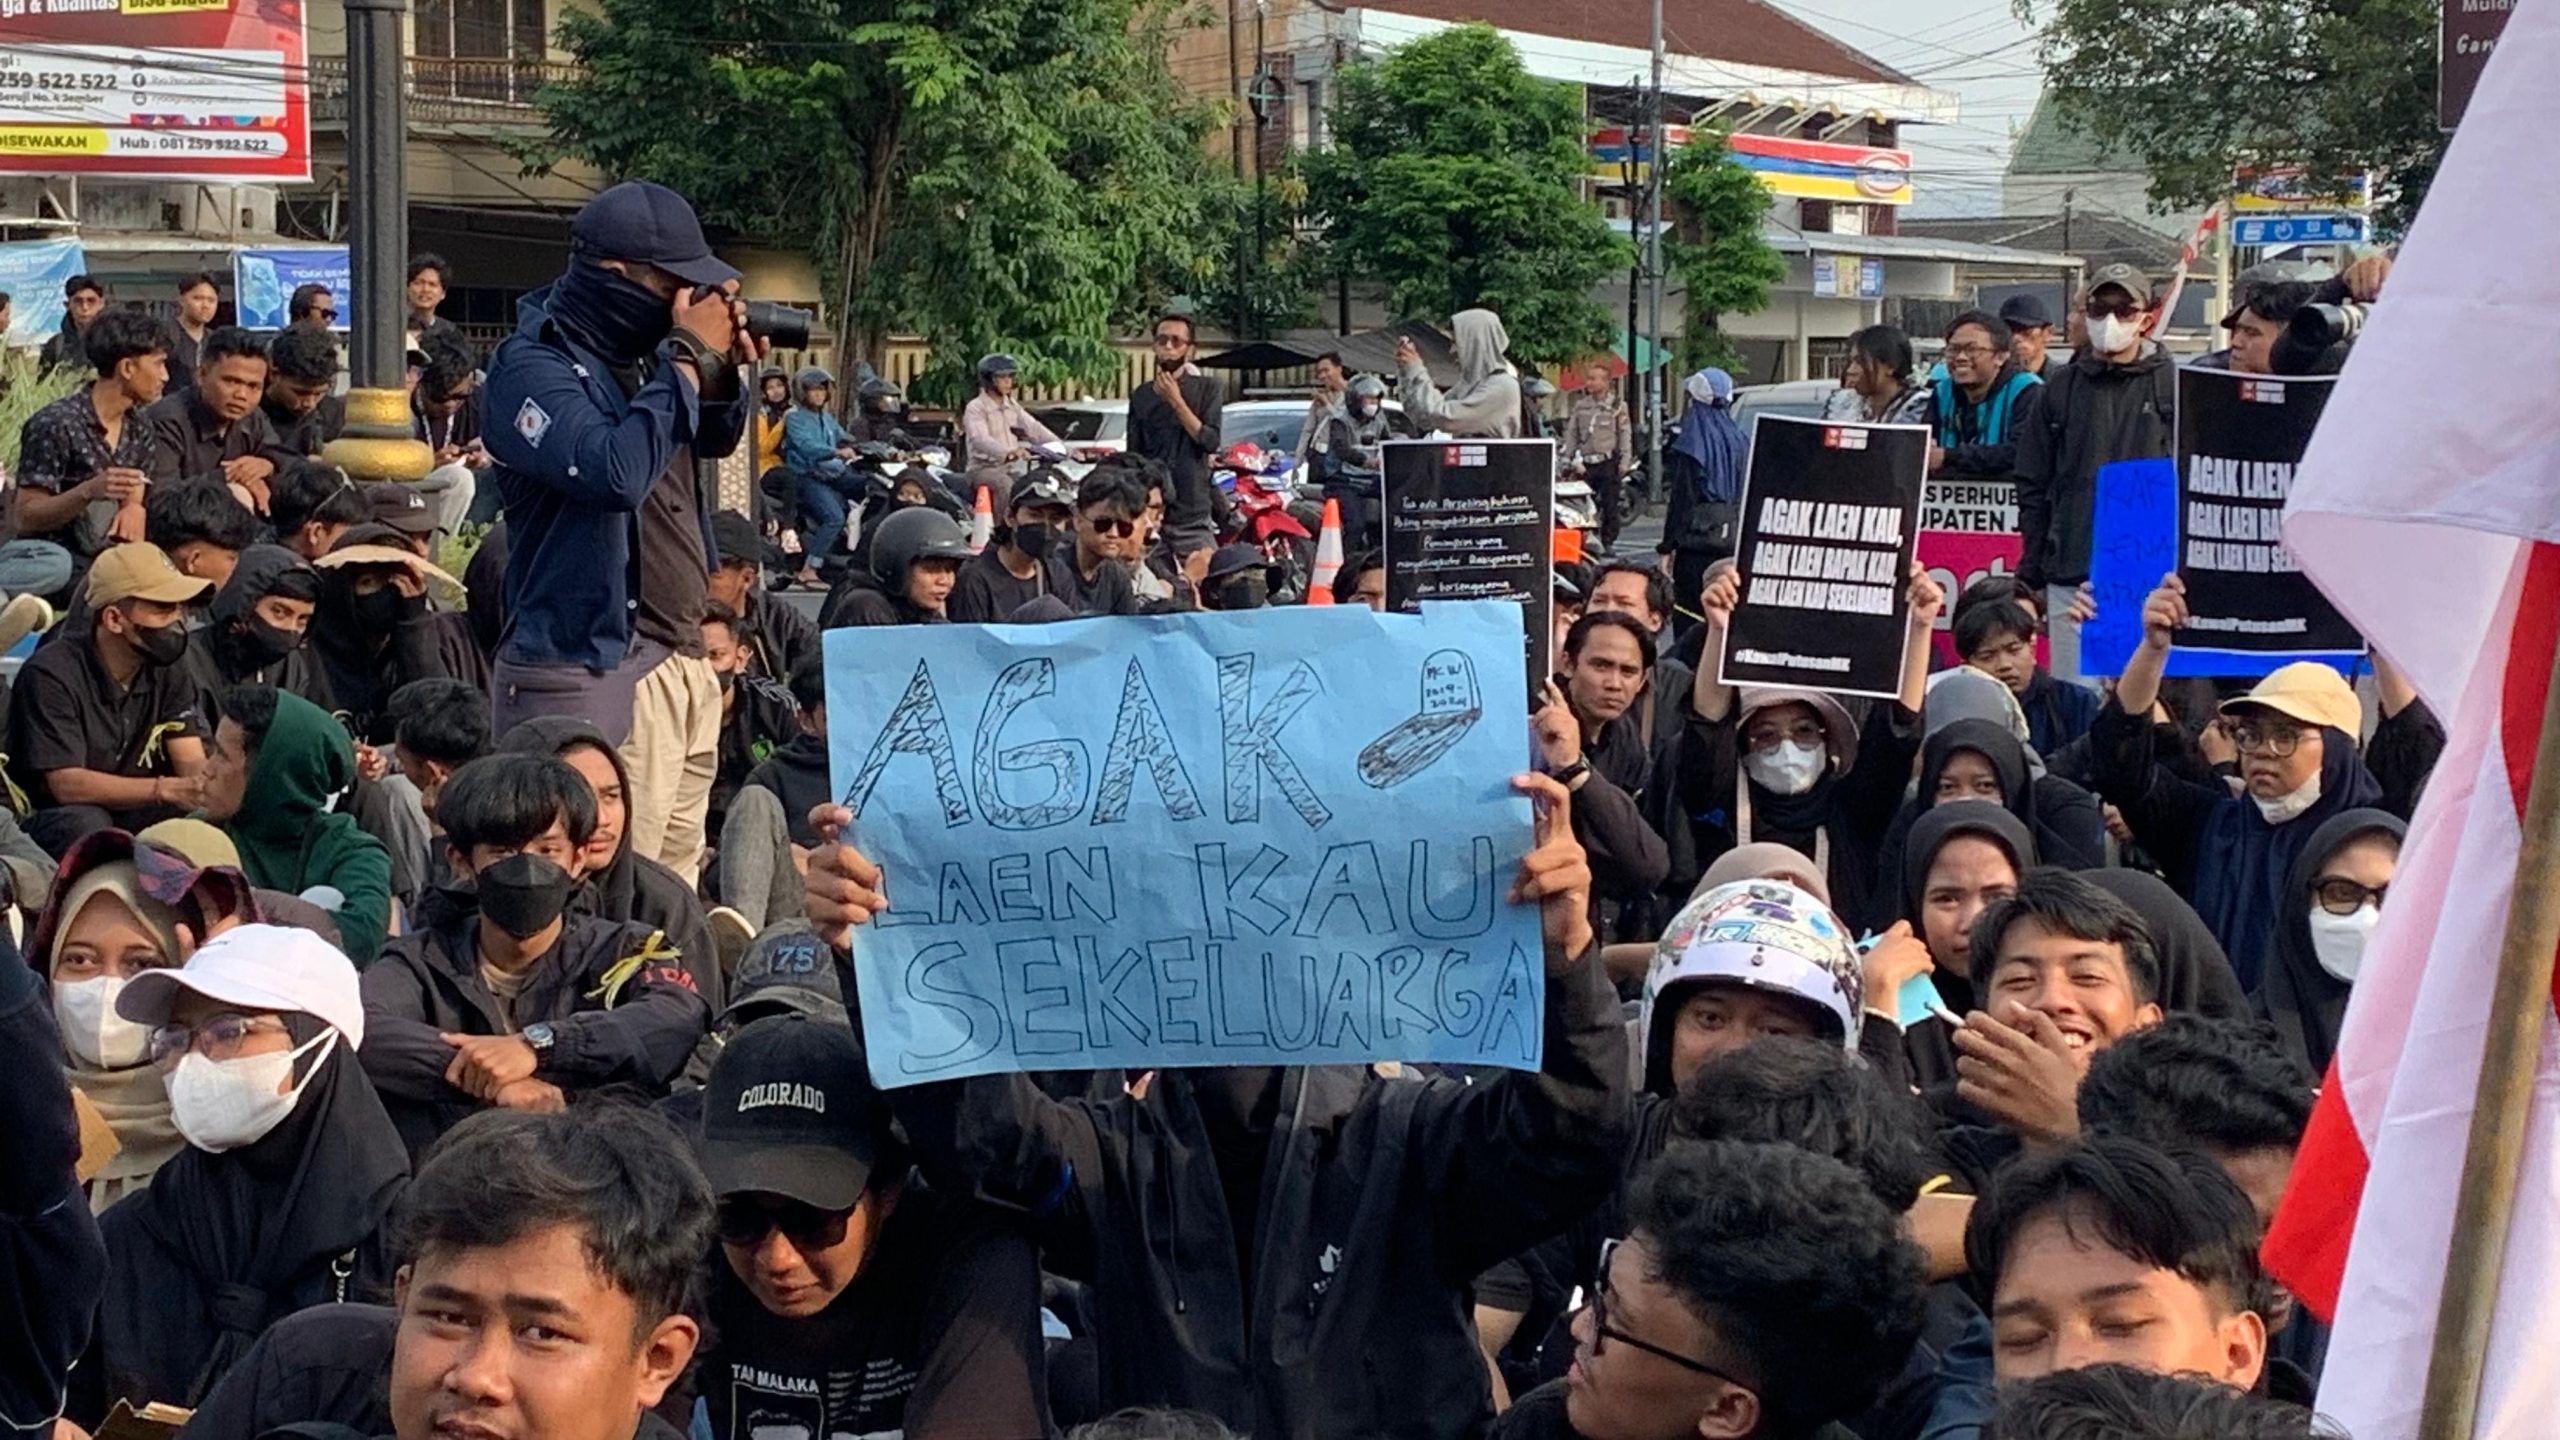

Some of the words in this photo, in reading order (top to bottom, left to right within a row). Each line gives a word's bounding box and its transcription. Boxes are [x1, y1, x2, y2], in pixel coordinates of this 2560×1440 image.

[38, 72, 76, 90] 522
[80, 73, 118, 90] 522
[120, 137, 149, 149] Hub
[160, 138, 184, 150] 081
[187, 138, 212, 150] 259
[214, 139, 241, 151] 522
[243, 139, 269, 151] 522
[2188, 454, 2240, 498] AGAK
[2241, 460, 2293, 500] LAEN
[1757, 496, 1815, 538] AGAK
[1812, 502, 1863, 542] LAEN
[1860, 506, 1904, 549] KAU,
[2187, 501, 2224, 539] AGAK
[2224, 505, 2258, 541] LAEN
[1752, 541, 1793, 577] AGAK
[1789, 544, 1826, 579] LAEN
[1822, 547, 1870, 582] BAPAK
[2186, 539, 2218, 571] AGAK
[1747, 577, 1781, 605] AGAK
[1777, 579, 1806, 608] LAEN
[1802, 581, 1830, 610] KAU
[1826, 583, 1895, 617] SEKELUARGA
[842, 651, 1334, 831] AGAK
[873, 845, 1118, 930] LAEN
[1196, 835, 1496, 941] KAU
[774, 945, 815, 973] 75
[898, 934, 1539, 1074] SEKELUARGA
[737, 1081, 826, 1114] COLORADO
[757, 1369, 820, 1393] MALAKA
